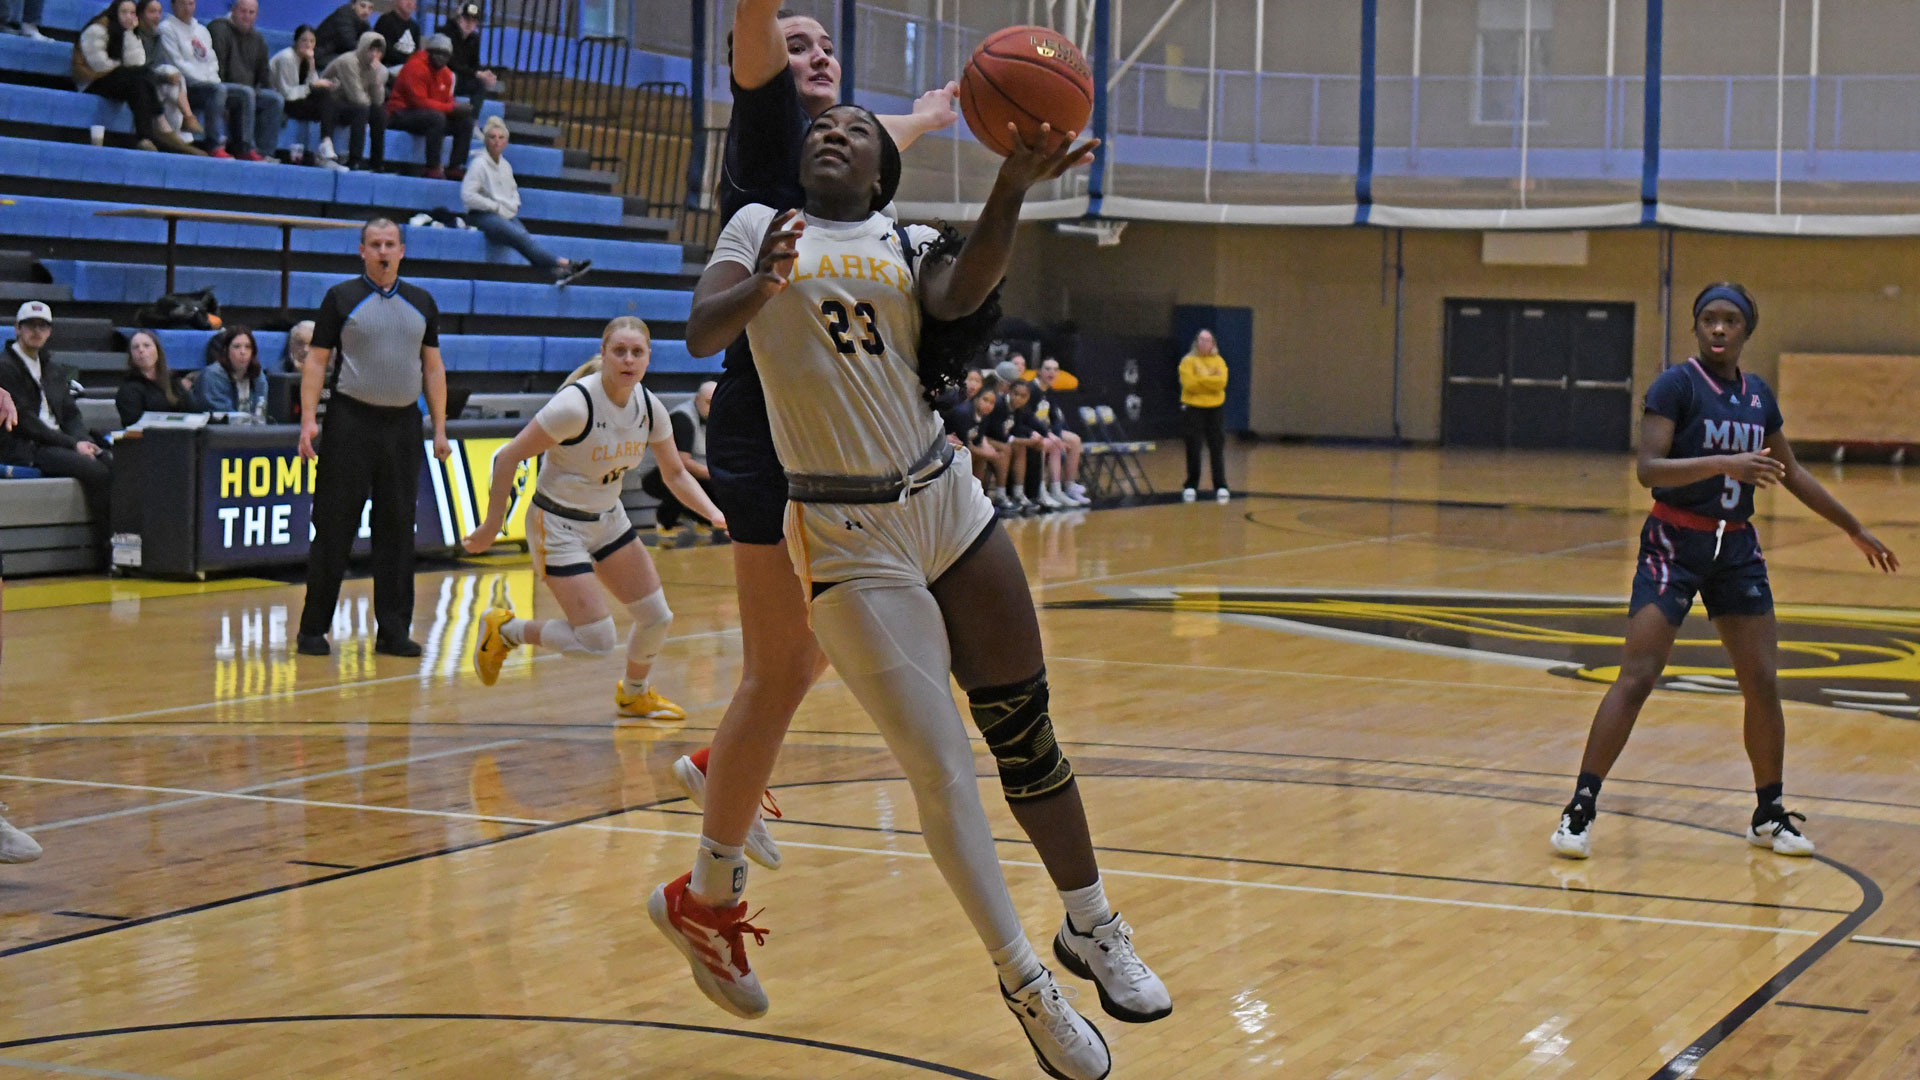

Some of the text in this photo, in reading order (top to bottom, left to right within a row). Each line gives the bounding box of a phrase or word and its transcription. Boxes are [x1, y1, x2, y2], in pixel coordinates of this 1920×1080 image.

[793, 254, 913, 300] LARKE
[818, 298, 886, 356] 23
[1703, 418, 1765, 454] MNU
[1720, 473, 1741, 509] 5
[218, 504, 292, 548] THE
